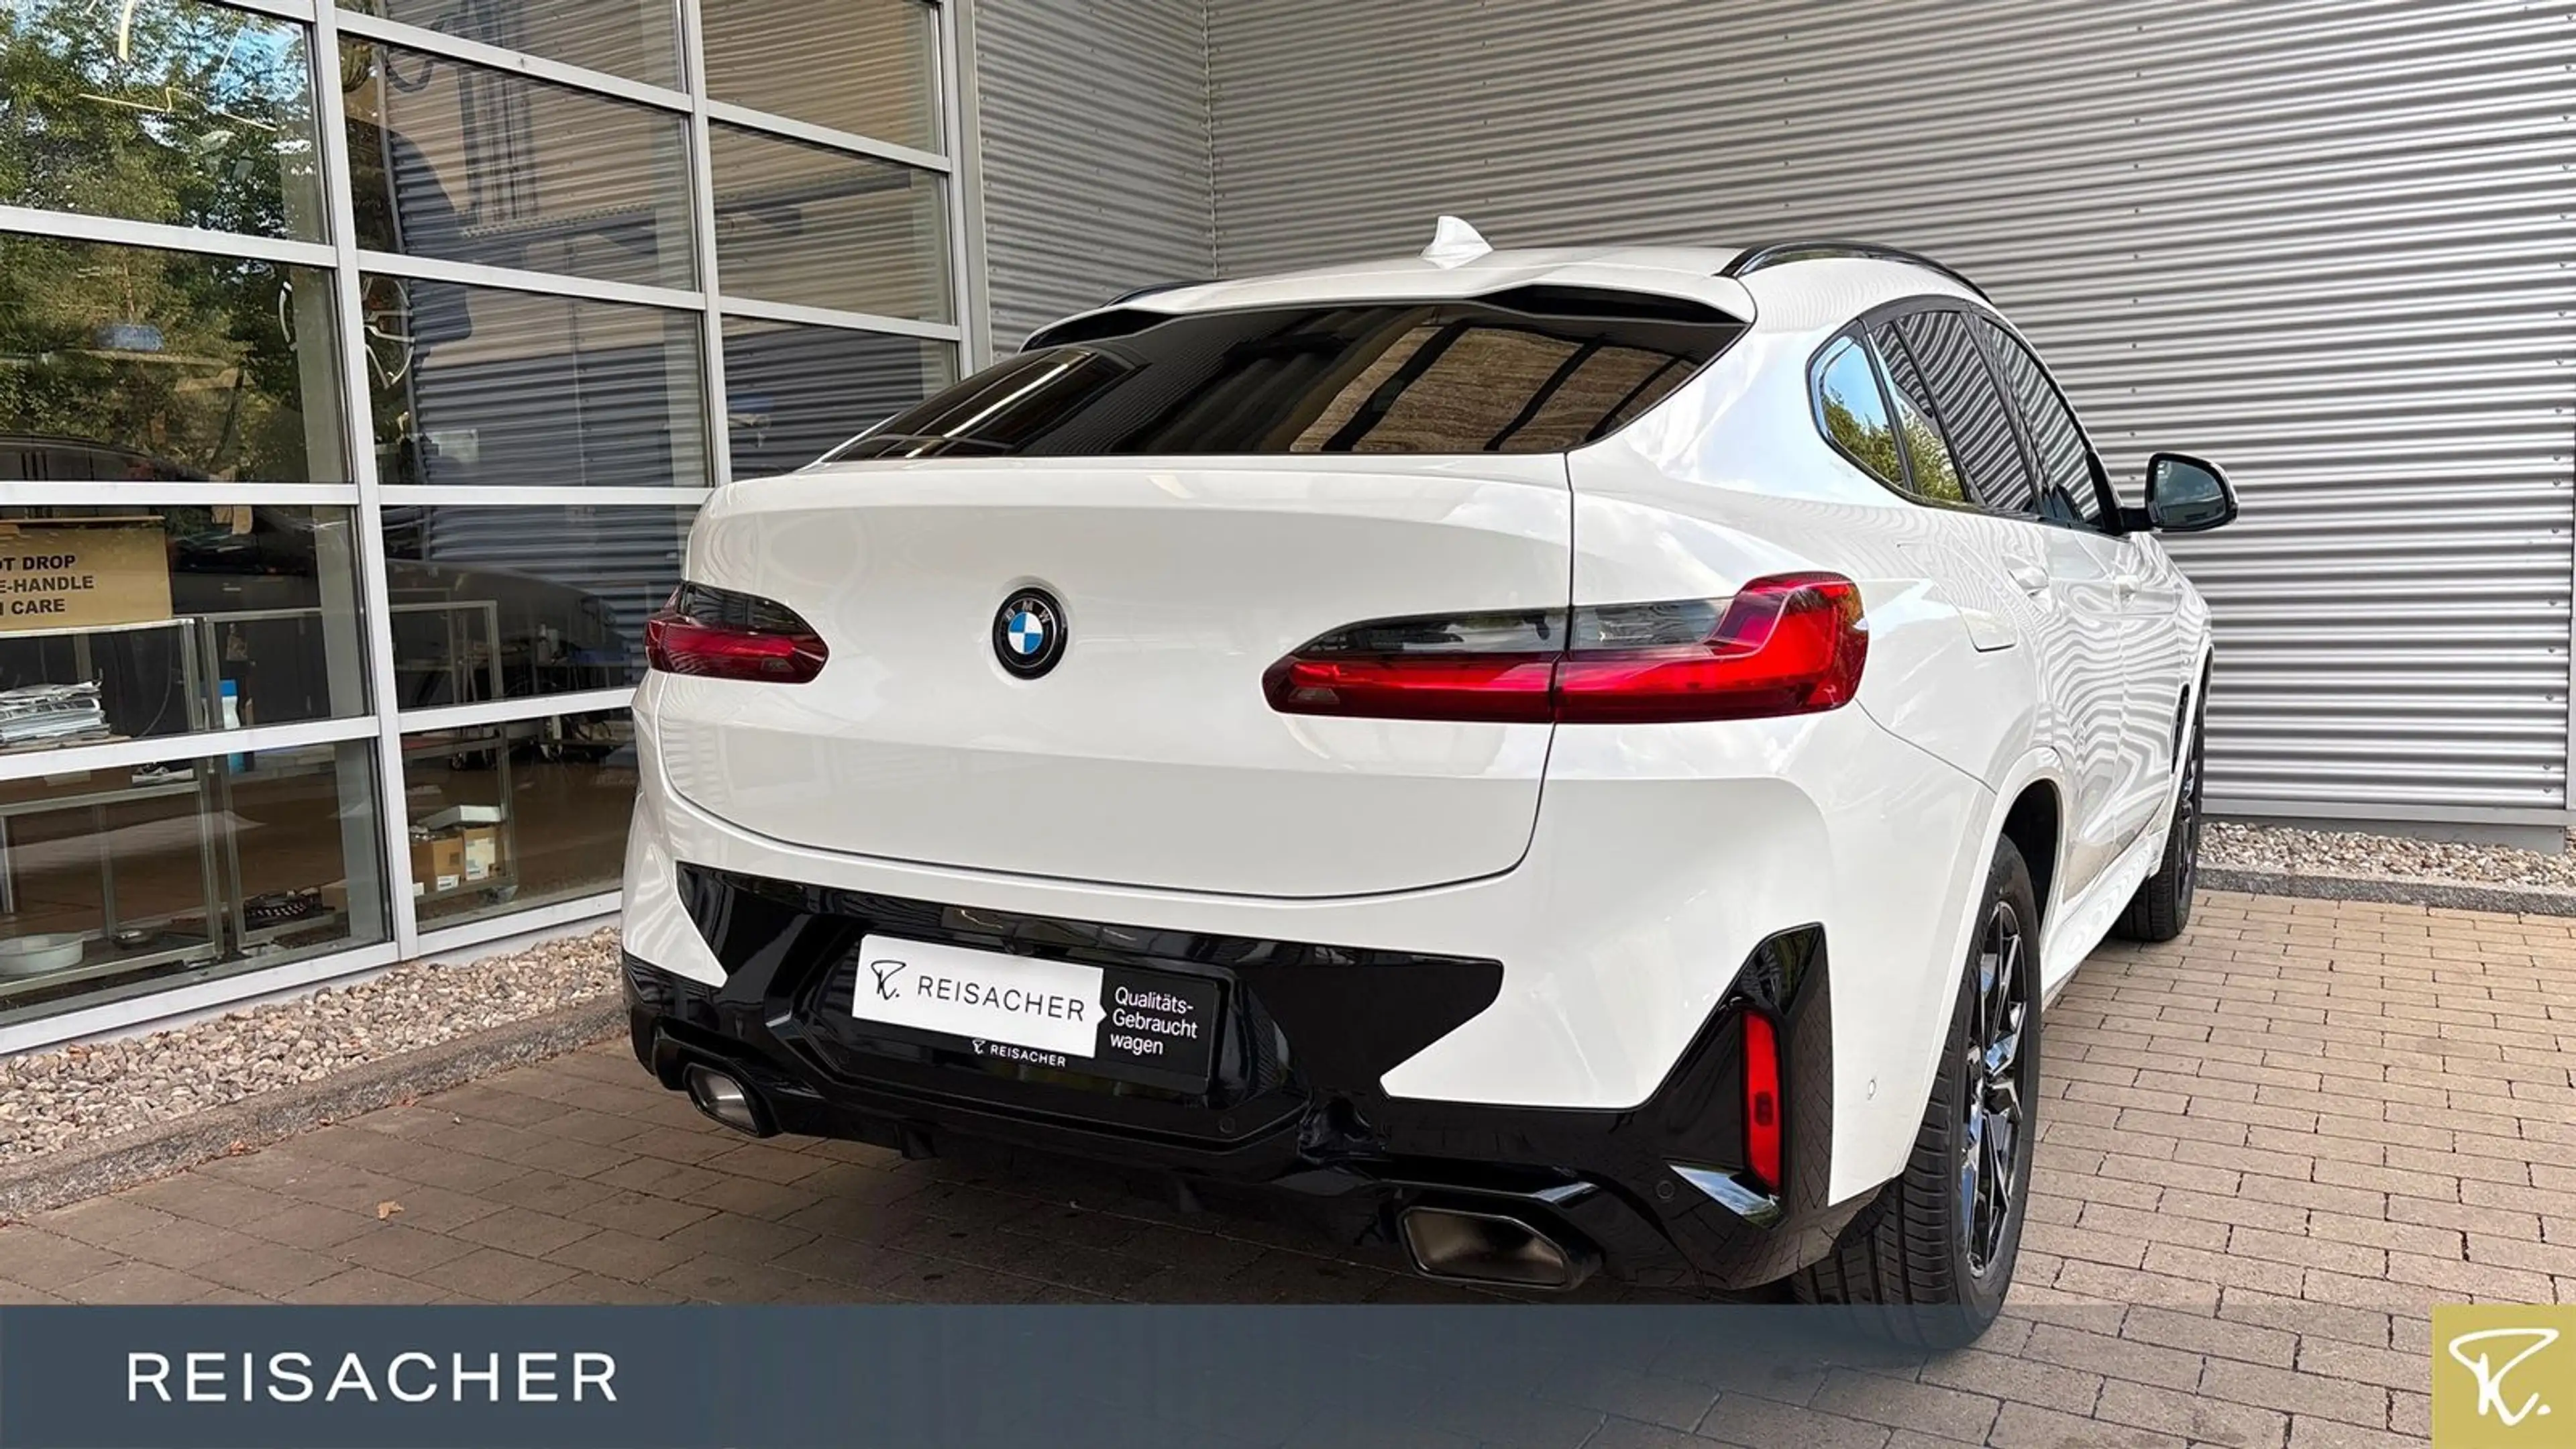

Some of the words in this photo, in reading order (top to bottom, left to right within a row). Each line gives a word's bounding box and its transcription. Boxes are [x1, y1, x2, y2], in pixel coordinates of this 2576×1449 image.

[0, 557, 16, 571] T
[23, 555, 76, 570] DROP
[11, 598, 65, 614] CARE
[1004, 600, 1051, 625] BMW
[918, 975, 1085, 1022] REISACHER
[1115, 986, 1194, 1014] Qualitäts-
[1112, 1008, 1198, 1039] Gebraucht
[989, 1044, 1067, 1067] REISACHER
[1110, 1033, 1164, 1056] wagen
